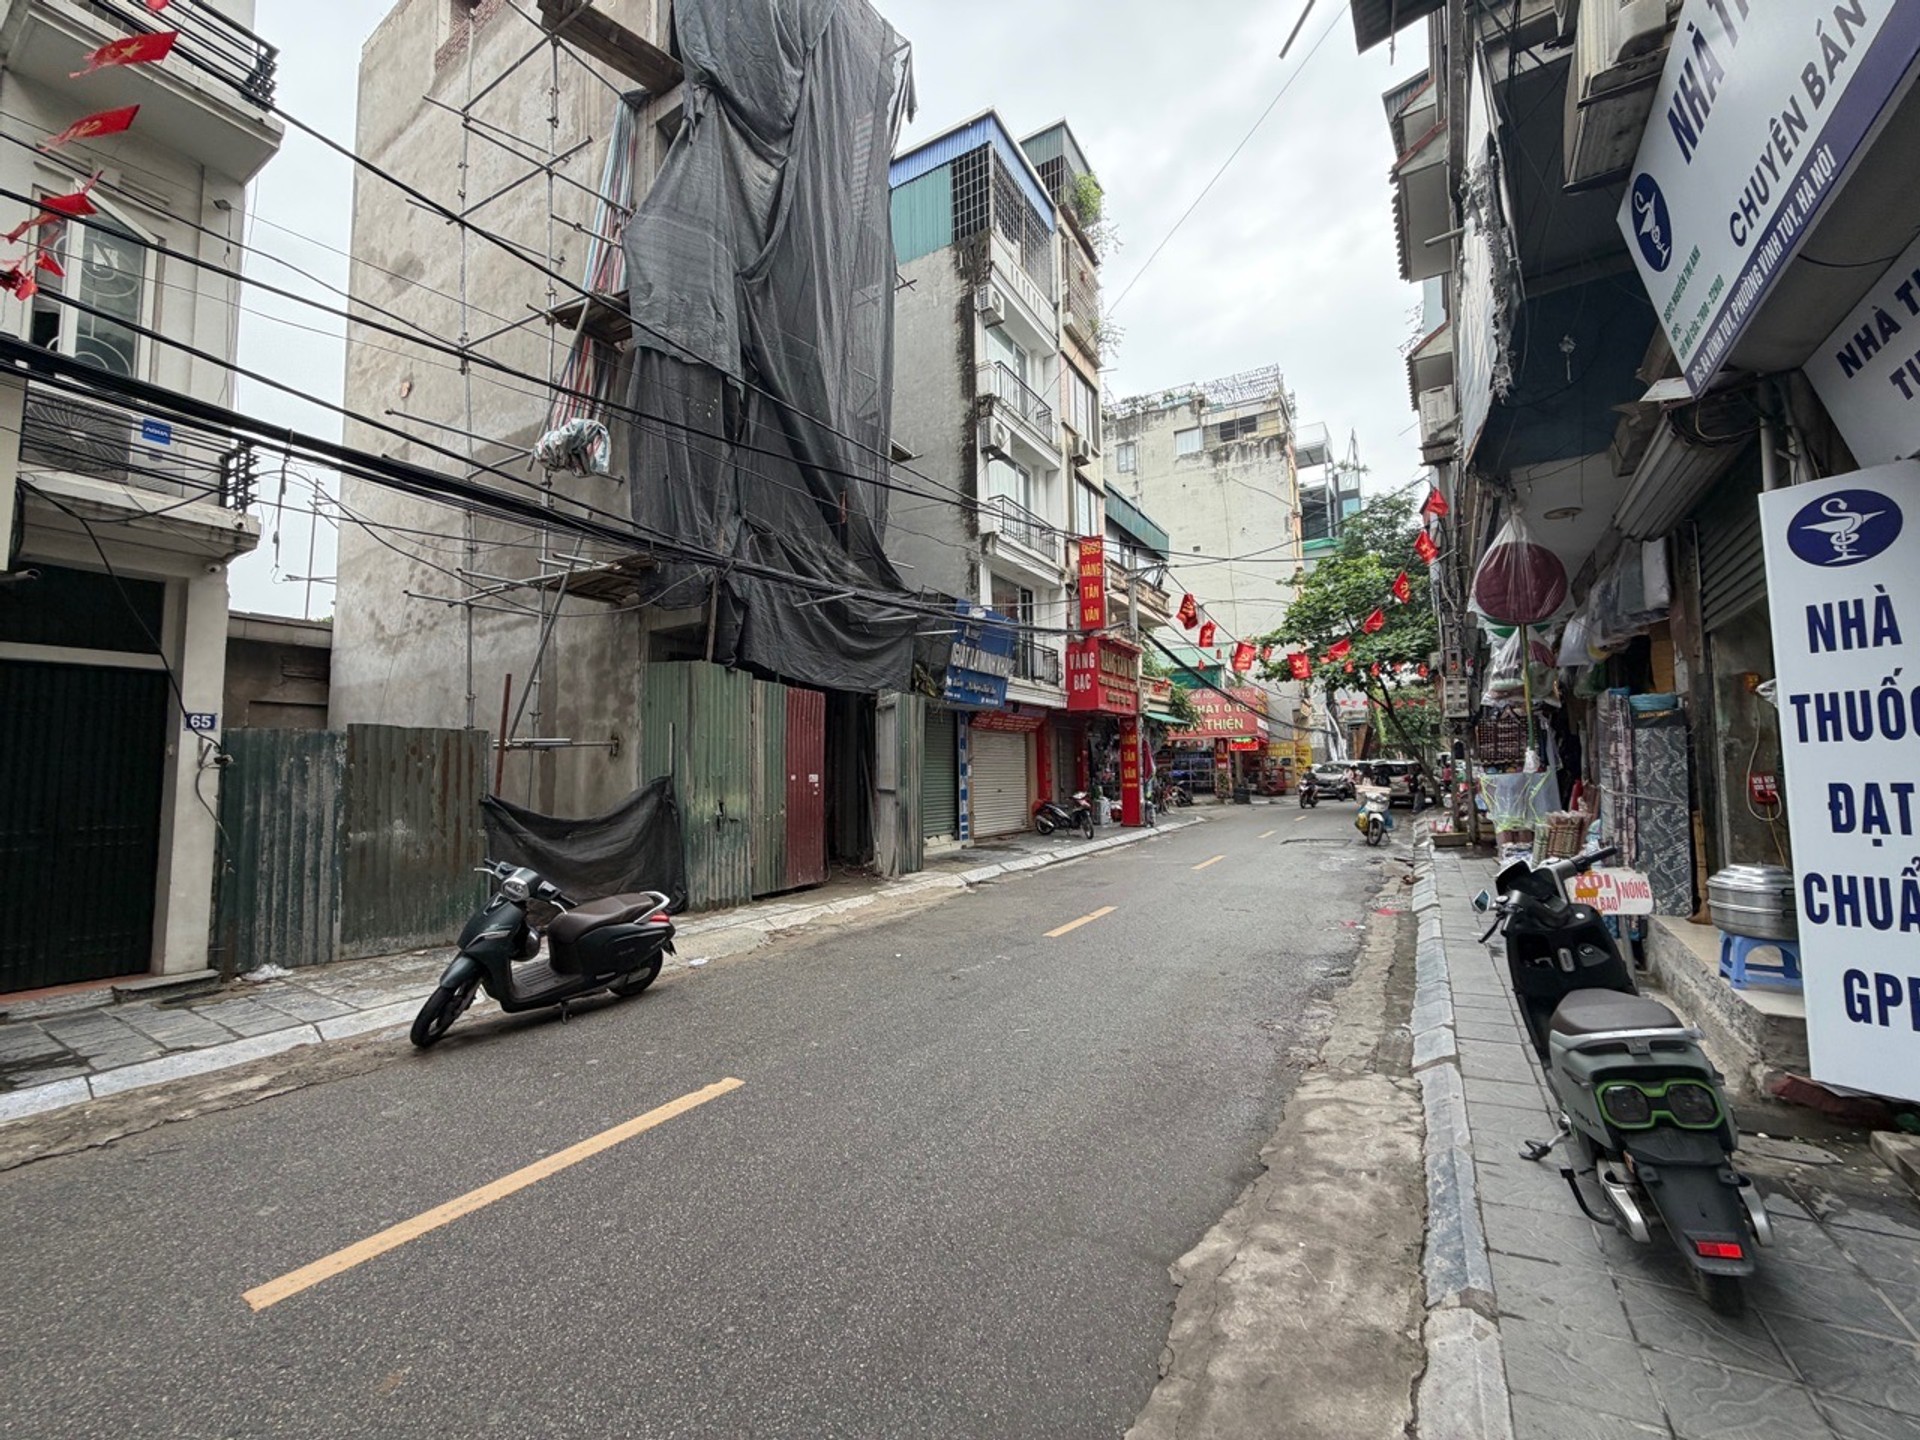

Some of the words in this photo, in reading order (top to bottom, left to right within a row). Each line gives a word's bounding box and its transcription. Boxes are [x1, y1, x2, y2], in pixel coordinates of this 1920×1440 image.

[1667, 21, 1724, 165] NHÀ
[1708, 0, 1750, 47] T
[1729, 95, 1808, 247] CHUYÊN
[1801, 0, 1867, 110] BÁN
[1731, 265, 1764, 321] PHƯỜNG
[1758, 231, 1784, 275] VĨNH
[1777, 203, 1802, 244] TUY,
[1795, 177, 1816, 213] HÀ
[1809, 144, 1837, 190] NỘI
[1835, 305, 1902, 379] NHÀ
[1894, 268, 1920, 316] T
[1806, 584, 1903, 653] NHÀ
[1070, 650, 1095, 670] VÀNG
[1074, 673, 1091, 693] BẠC
[190, 715, 212, 728] 65
[1828, 783, 1914, 847] ĐẠT
[1621, 878, 1650, 899] NÓNG
